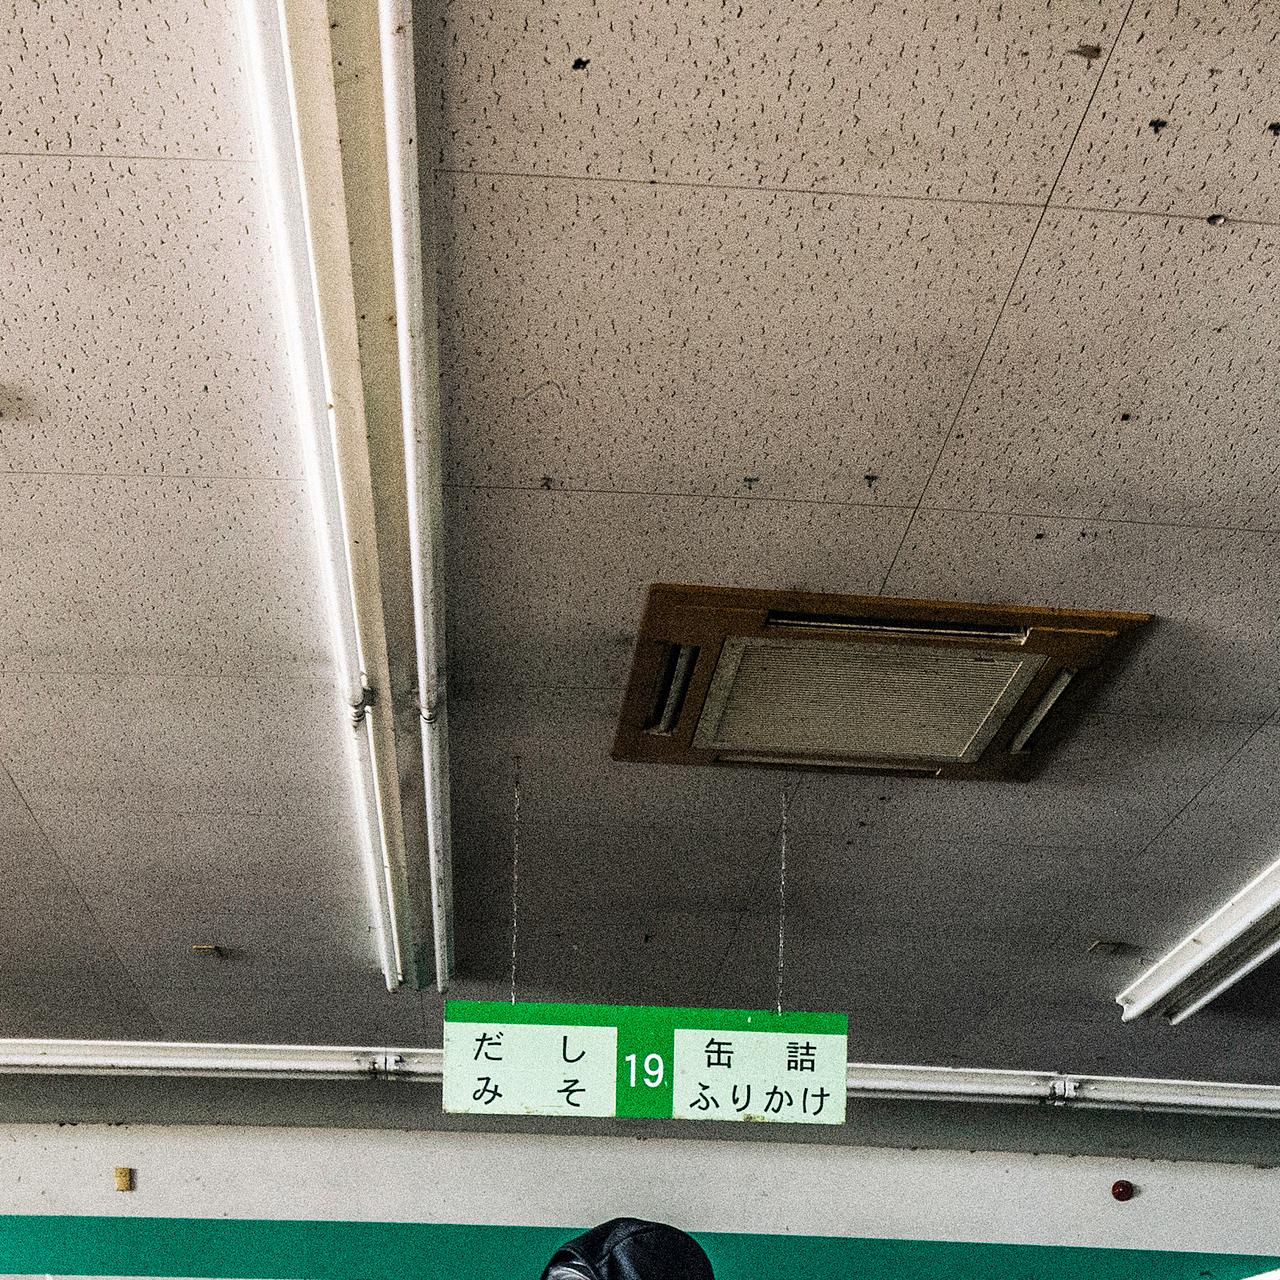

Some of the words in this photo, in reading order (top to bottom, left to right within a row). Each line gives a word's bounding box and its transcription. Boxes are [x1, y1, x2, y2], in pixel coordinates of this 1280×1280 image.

[473, 1030, 587, 1065] だし
[704, 1037, 818, 1073] 缶詰
[624, 1053, 665, 1088] 19
[472, 1075, 588, 1108] みそ
[689, 1081, 831, 1117] ふりかけ
